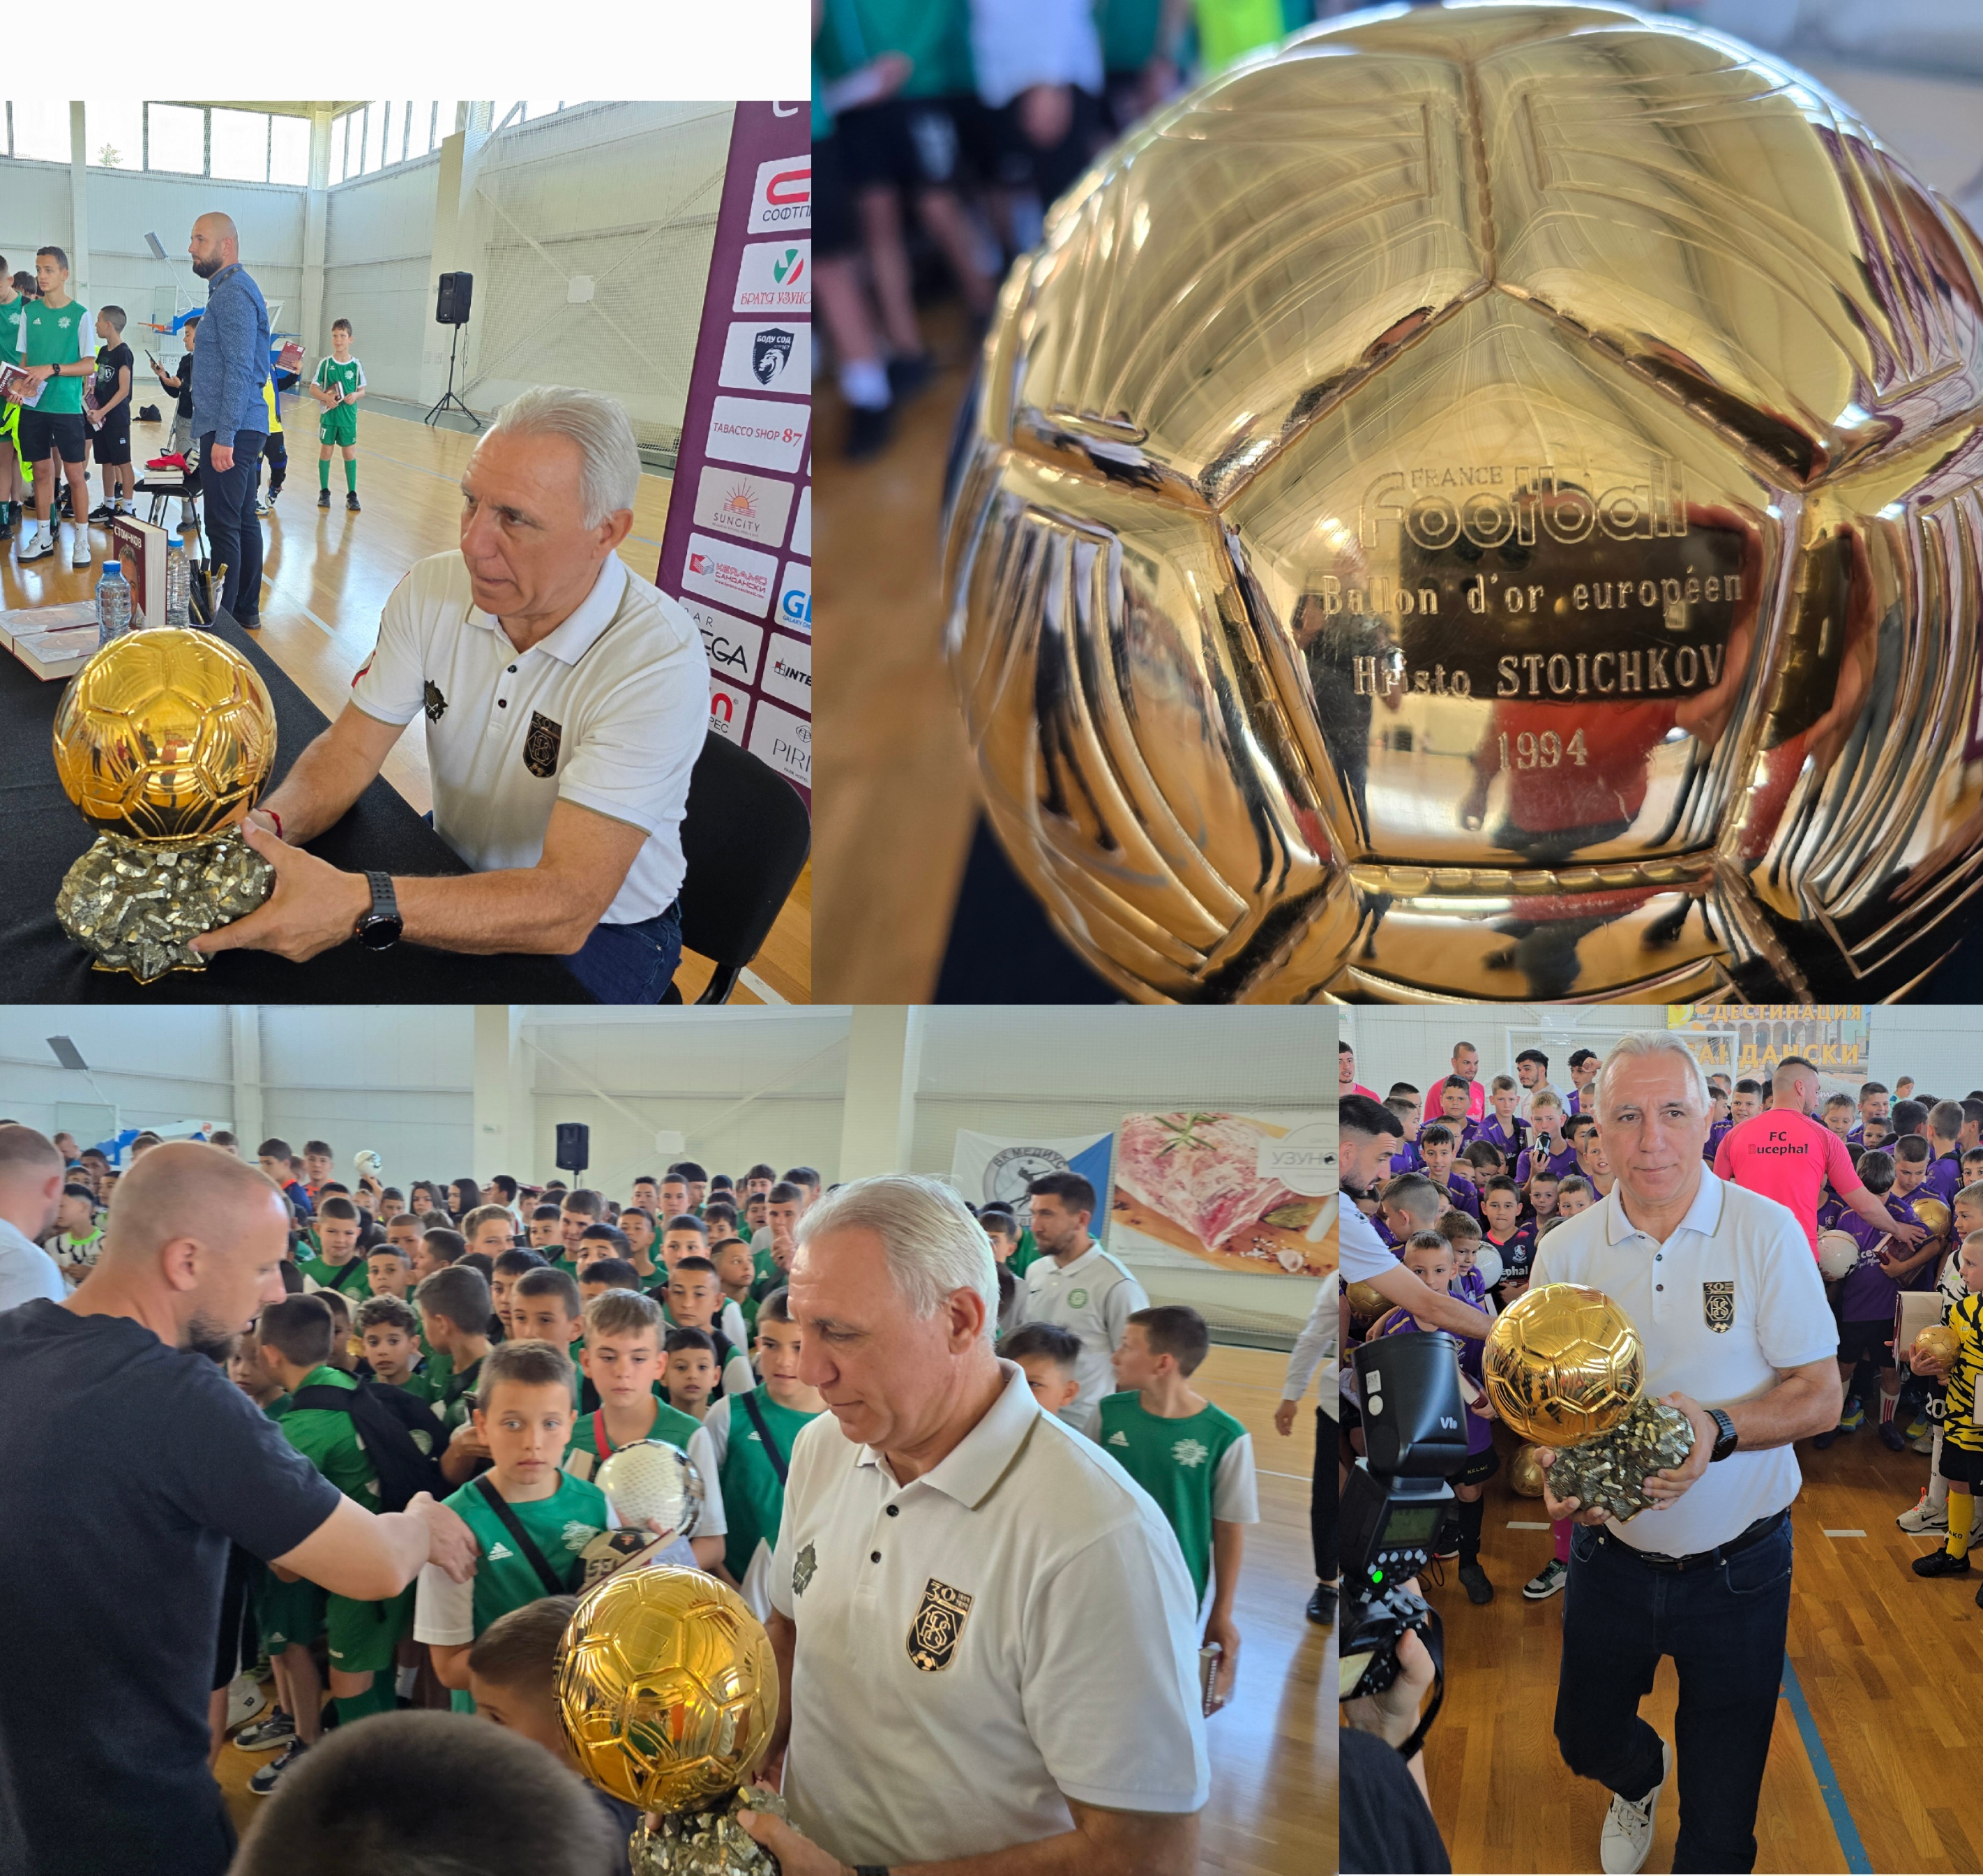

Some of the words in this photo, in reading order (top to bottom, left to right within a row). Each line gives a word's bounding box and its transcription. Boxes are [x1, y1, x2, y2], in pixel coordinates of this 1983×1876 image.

[763, 205, 811, 222] СОФТП
[741, 292, 774, 305] БРАТЯ
[776, 336, 791, 345] СОД
[714, 422, 753, 437] TABACCO
[755, 428, 780, 441] SHOP
[782, 428, 802, 447] 87
[1410, 466, 1503, 488] FRANCE
[1359, 459, 1688, 550] football
[714, 512, 760, 532] SUNCITY
[114, 525, 142, 548] СТОИЧКОВ
[715, 571, 766, 593] САНДАНСКИ
[716, 562, 767, 586] KERAMO
[1323, 575, 1438, 616] Ballon
[1467, 573, 1544, 614] d'or
[1573, 566, 1743, 617] européen
[783, 615, 802, 625] GALAXY
[1352, 655, 1471, 696] Hristo
[1498, 643, 1724, 696] STOICHKOV
[1498, 728, 1588, 769] 1994
[1712, 1005, 1862, 1023] ДЕСТИНАЦИЯ
[1769, 1132, 1787, 1141] FC
[1748, 1143, 1808, 1155] Bucephal
